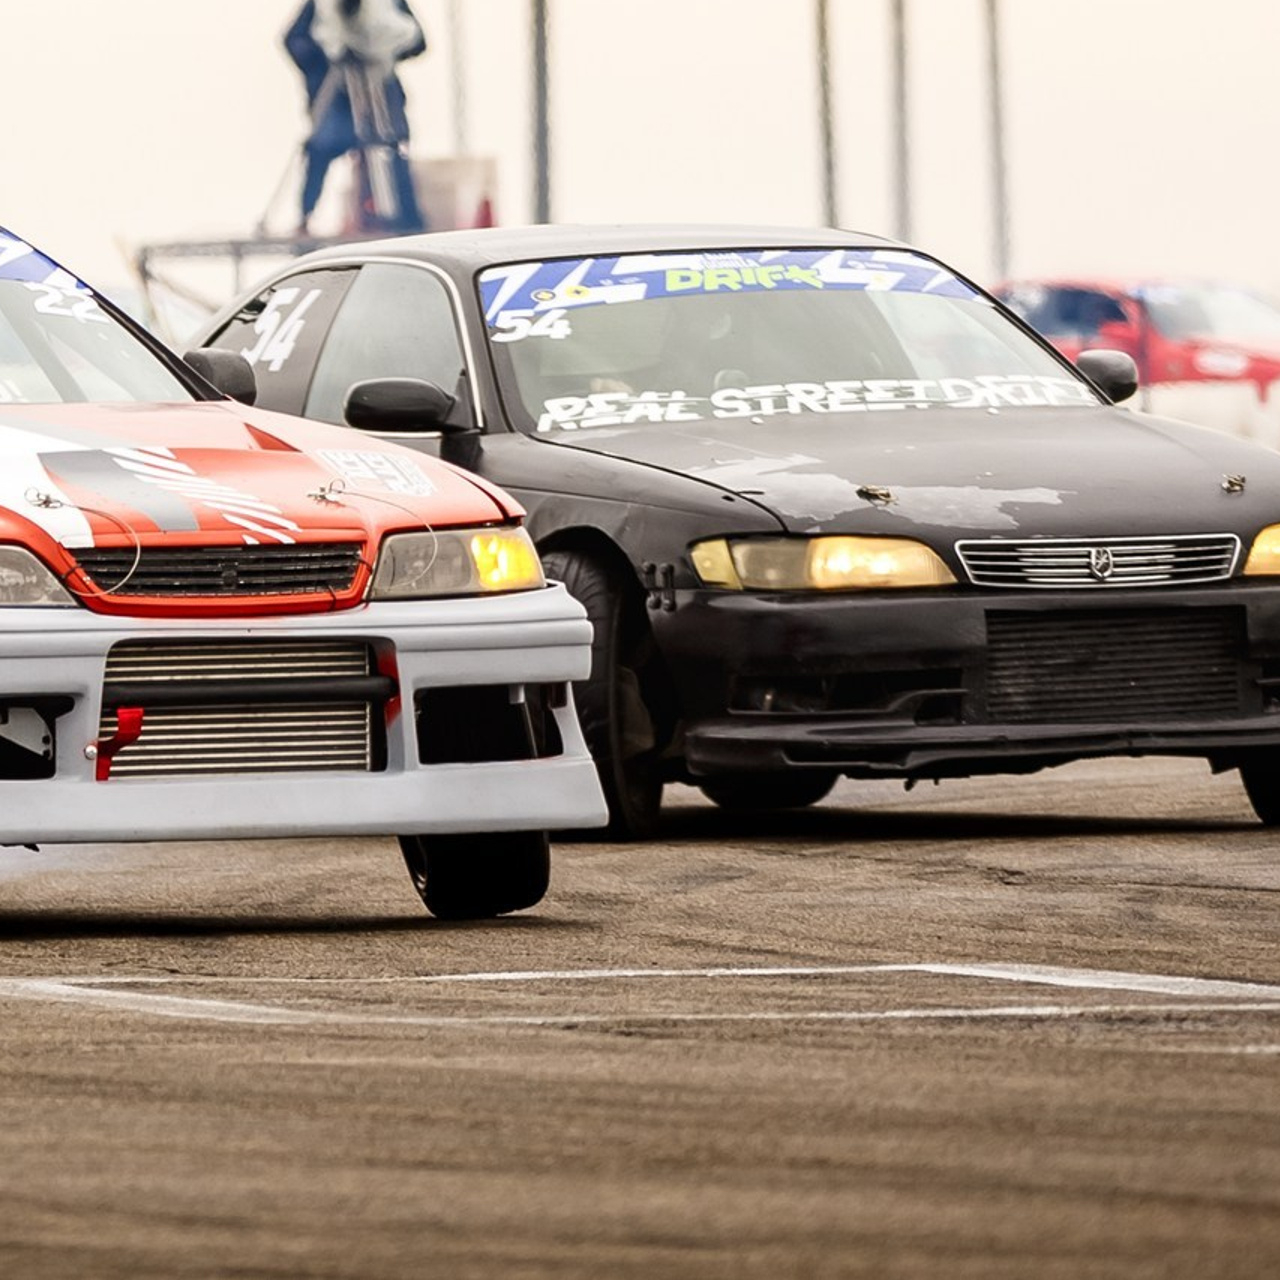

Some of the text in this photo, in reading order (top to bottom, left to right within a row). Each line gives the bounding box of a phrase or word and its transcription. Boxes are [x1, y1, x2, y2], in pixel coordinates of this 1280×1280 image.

[23, 281, 112, 324] 22
[240, 287, 322, 372] 54
[490, 308, 572, 342] 54
[536, 390, 705, 433] REAL
